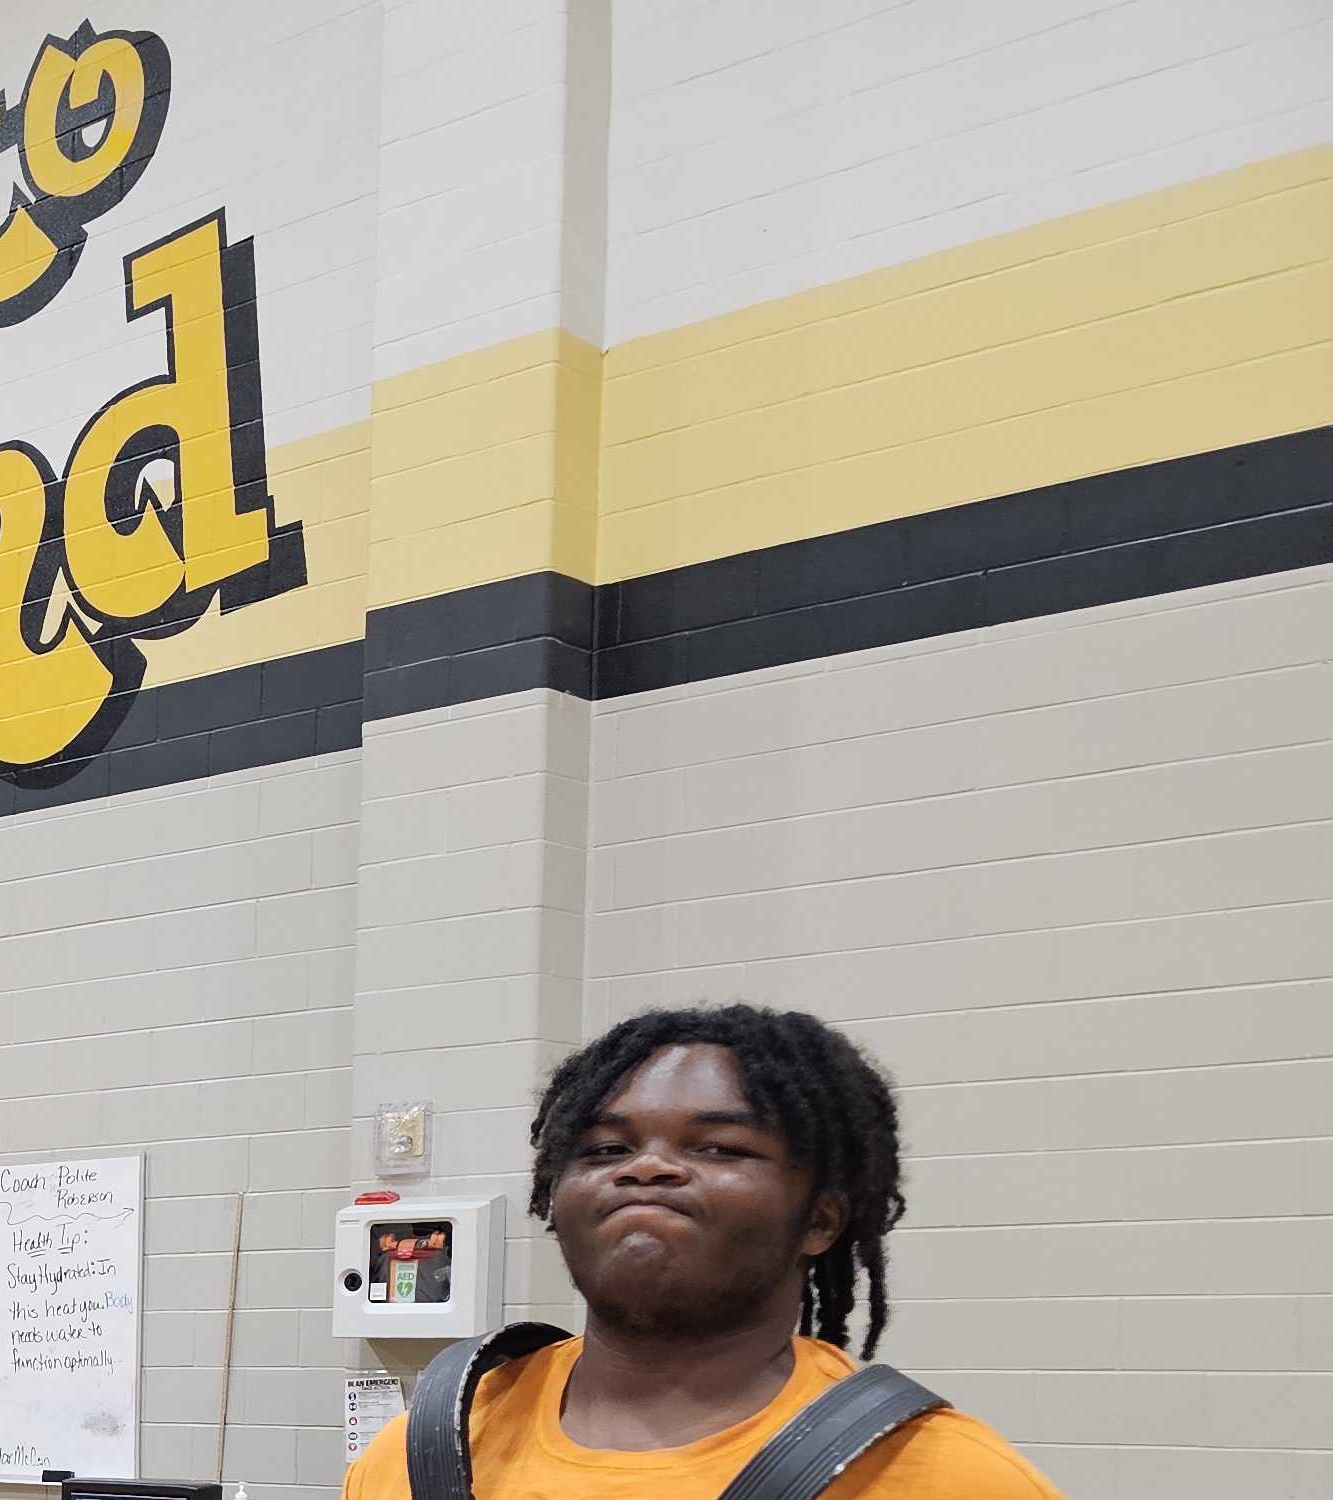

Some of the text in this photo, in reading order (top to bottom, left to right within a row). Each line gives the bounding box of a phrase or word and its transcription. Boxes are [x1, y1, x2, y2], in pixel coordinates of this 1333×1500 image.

[0, 1165, 98, 1193] Coach Polite
[12, 1221, 89, 1253] Health Tip:
[397, 1272, 415, 1281] AED
[8, 1300, 39, 1321] this
[44, 1297, 77, 1318] heat
[104, 1290, 134, 1315] Body
[87, 1321, 103, 1337] to
